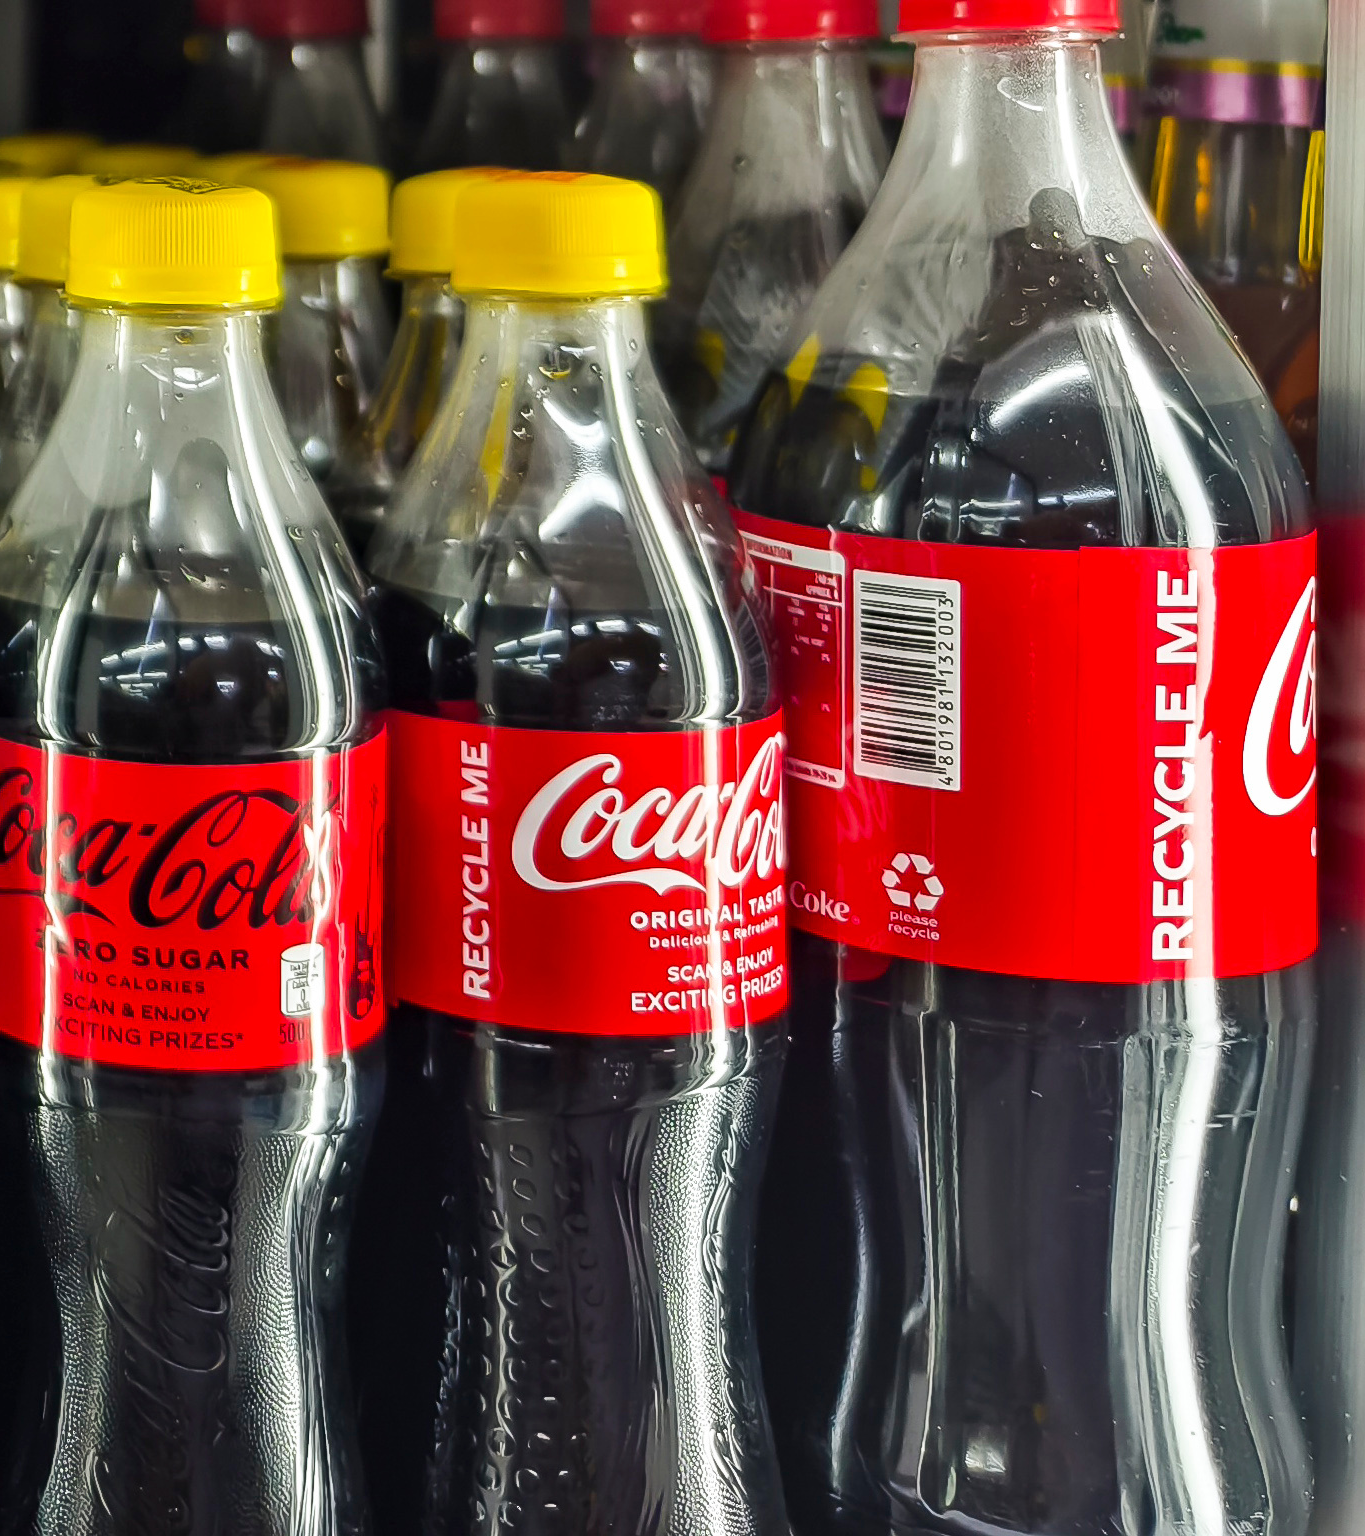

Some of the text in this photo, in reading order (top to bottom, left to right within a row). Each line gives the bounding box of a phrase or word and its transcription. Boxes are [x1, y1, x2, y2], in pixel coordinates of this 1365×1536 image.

[1152, 569, 1198, 960] RECYCLE ME
[461, 740, 489, 1000] RECYCLE ME
[630, 885, 783, 930] ORIGINAL TASTE
[790, 881, 850, 923] Coke
[888, 922, 940, 941] recycle
[889, 910, 938, 927] please
[132, 947, 250, 970] SUGAR
[737, 946, 773, 973] ENJOY
[74, 970, 205, 994] NO CALORIES
[64, 993, 210, 1023] SCAN ENJOY
[631, 985, 736, 1012] EXCITING
